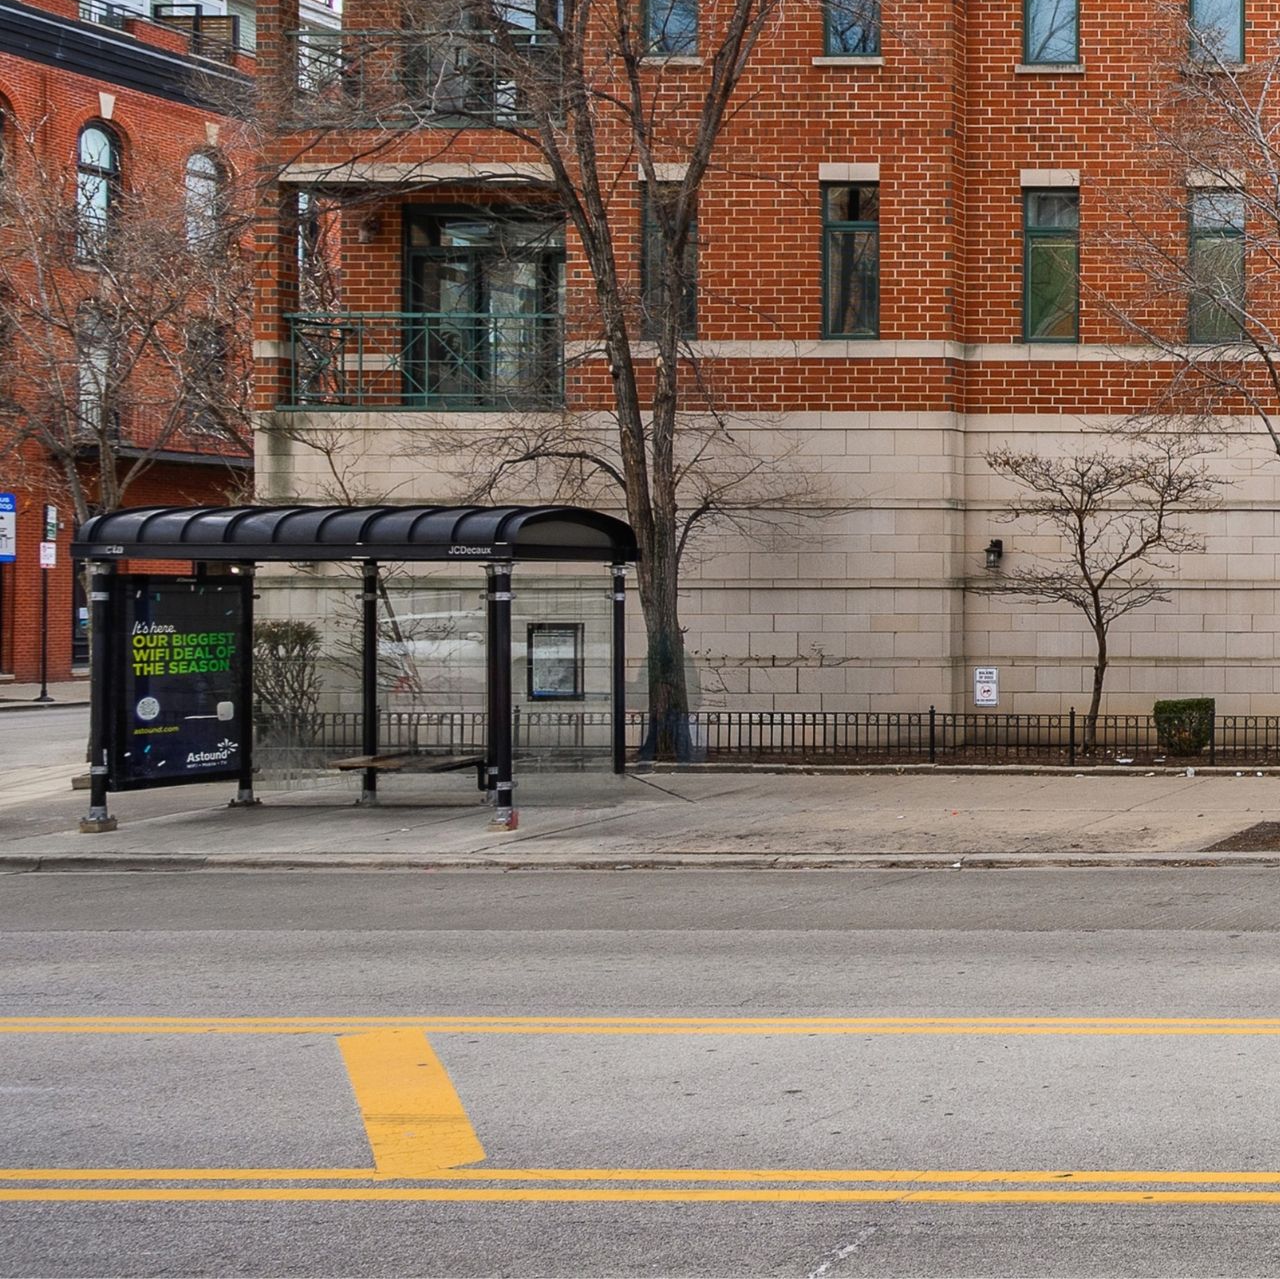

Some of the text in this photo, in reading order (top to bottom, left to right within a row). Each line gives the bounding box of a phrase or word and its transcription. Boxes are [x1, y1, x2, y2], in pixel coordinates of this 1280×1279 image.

[448, 545, 491, 555] JCDecaux
[132, 621, 176, 635] It's here.
[132, 632, 235, 648] OUR BIGGEST
[132, 646, 236, 661] WIFI DEAL OF
[132, 660, 230, 676] THE SEASON
[133, 725, 179, 735] astound.com
[186, 750, 228, 763] Astound
